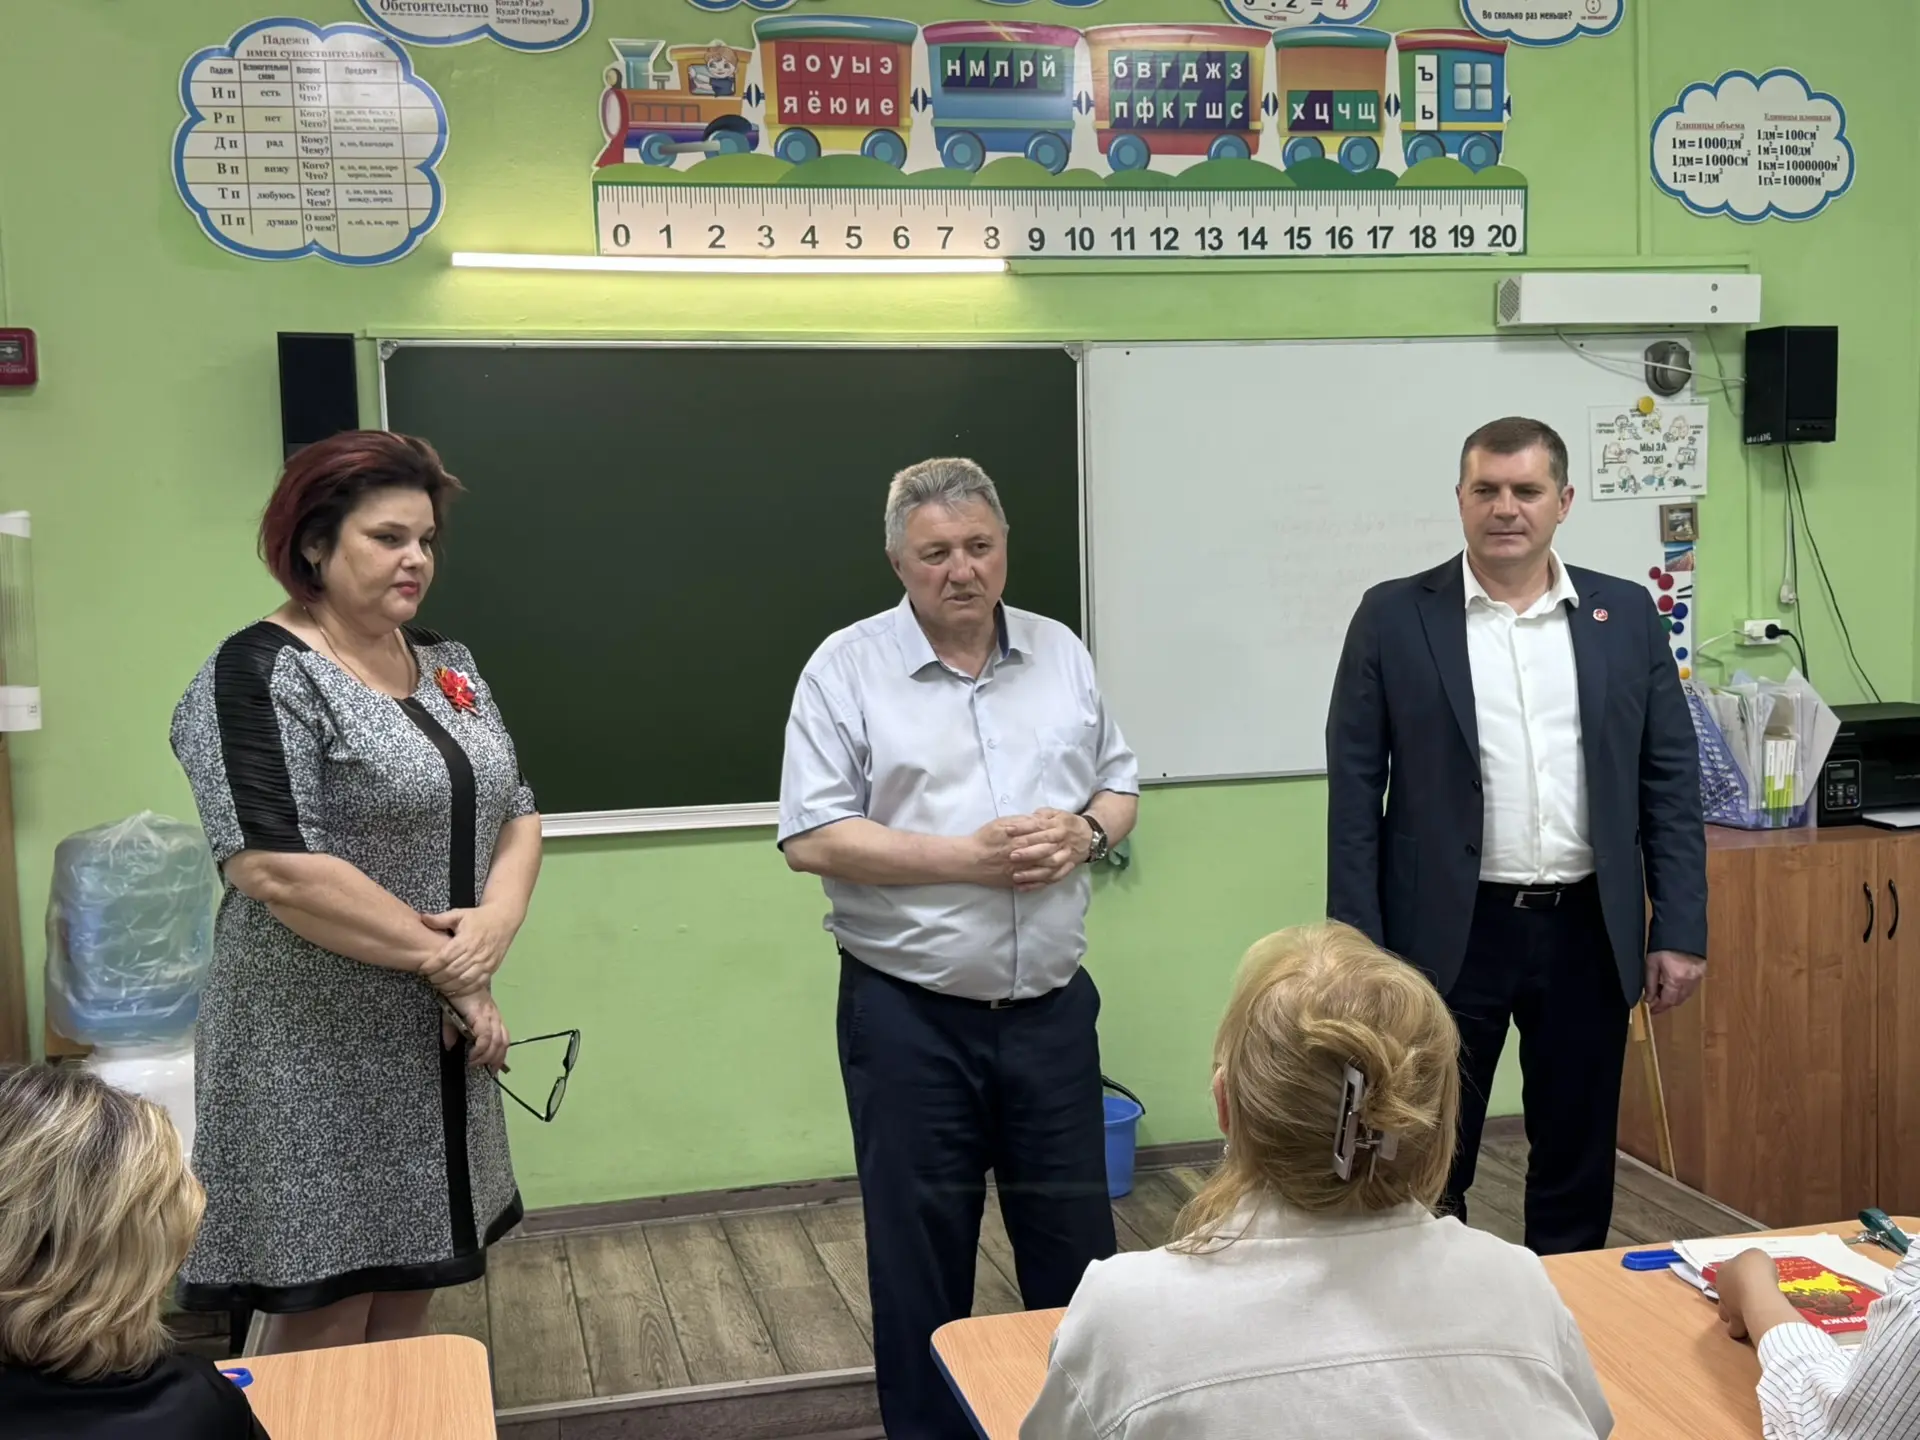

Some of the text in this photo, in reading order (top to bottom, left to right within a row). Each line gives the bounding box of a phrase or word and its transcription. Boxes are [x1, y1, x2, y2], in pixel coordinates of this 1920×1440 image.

[380, 0, 489, 14] Обстоятельство
[496, 8, 554, 17] Куда? Откуда?
[1482, 10, 1492, 20] Во
[1494, 11, 1523, 20] сколько
[1526, 12, 1538, 21] раз
[1540, 10, 1572, 20] меньше?
[262, 35, 310, 46] Падежи
[247, 50, 280, 58] имен
[210, 66, 233, 75] Падеж
[299, 84, 321, 92] Кто?
[212, 87, 236, 99] И п
[260, 89, 281, 97] есть
[299, 94, 322, 102] Что?
[214, 112, 235, 124] Р п
[264, 115, 282, 123] нет
[300, 110, 327, 119] Кого?
[301, 120, 328, 129] Чего?
[1676, 121, 1745, 130] Единицы объема
[214, 137, 238, 150] Д п
[266, 140, 284, 149] рад
[300, 136, 329, 146] Кому?
[301, 146, 329, 155] Чему?
[217, 163, 239, 175] В п
[264, 165, 289, 174] вижу
[302, 161, 330, 171] Кого?
[305, 172, 328, 180] Что?
[218, 187, 240, 199] Т п
[257, 190, 295, 201] любуюсь
[306, 188, 330, 197] Кем?
[307, 198, 331, 207] Чем?
[221, 214, 245, 226] П п
[304, 213, 336, 222] О ком?
[266, 218, 298, 228] думаю
[305, 224, 336, 232] О чем?
[613, 224, 1516, 251] 0 1 2 3 4 5 6 7 8 9 10 11 12 13 14 15 16 17 18 19 20
[1640, 443, 1667, 452] МЫ ЗА
